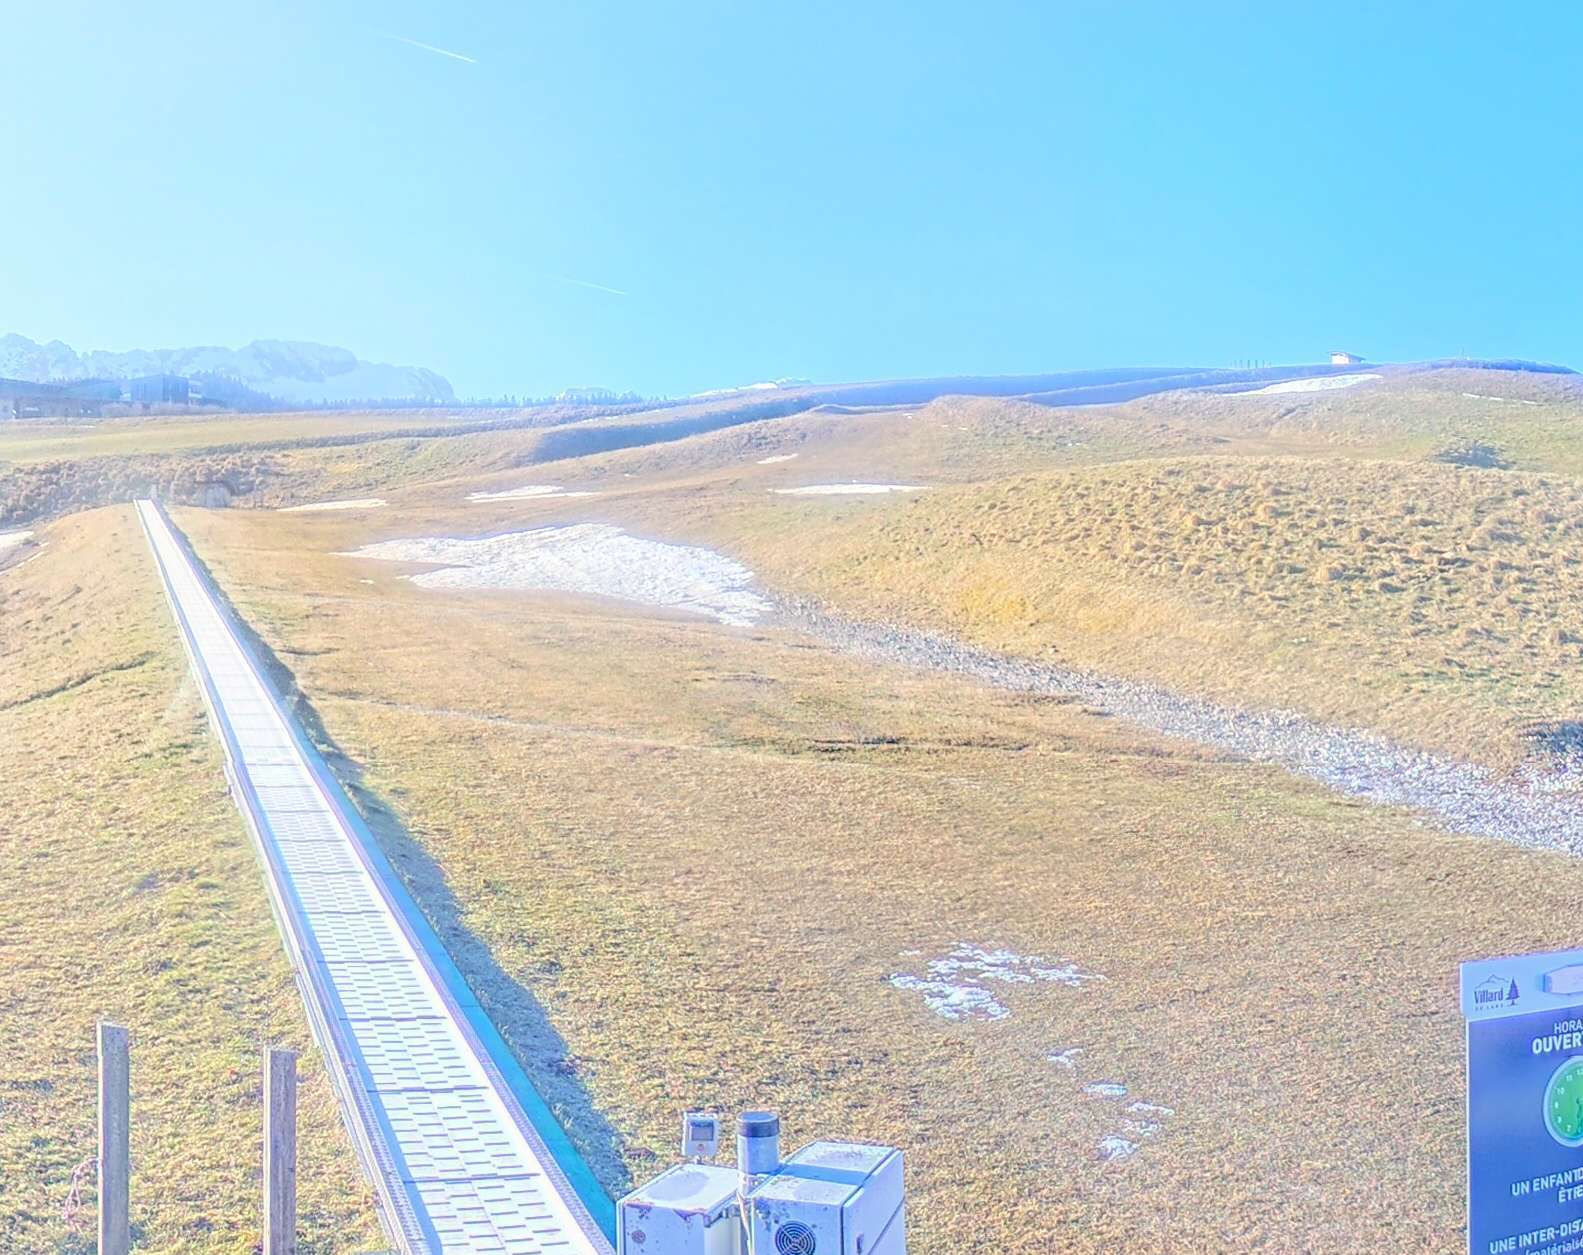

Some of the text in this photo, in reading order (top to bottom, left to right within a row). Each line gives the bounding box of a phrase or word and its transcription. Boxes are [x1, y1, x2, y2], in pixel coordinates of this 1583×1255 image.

[1474, 987, 1504, 1004] Villard
[1511, 1180, 1530, 1196] UN
[1490, 1236, 1516, 1254] UNE
